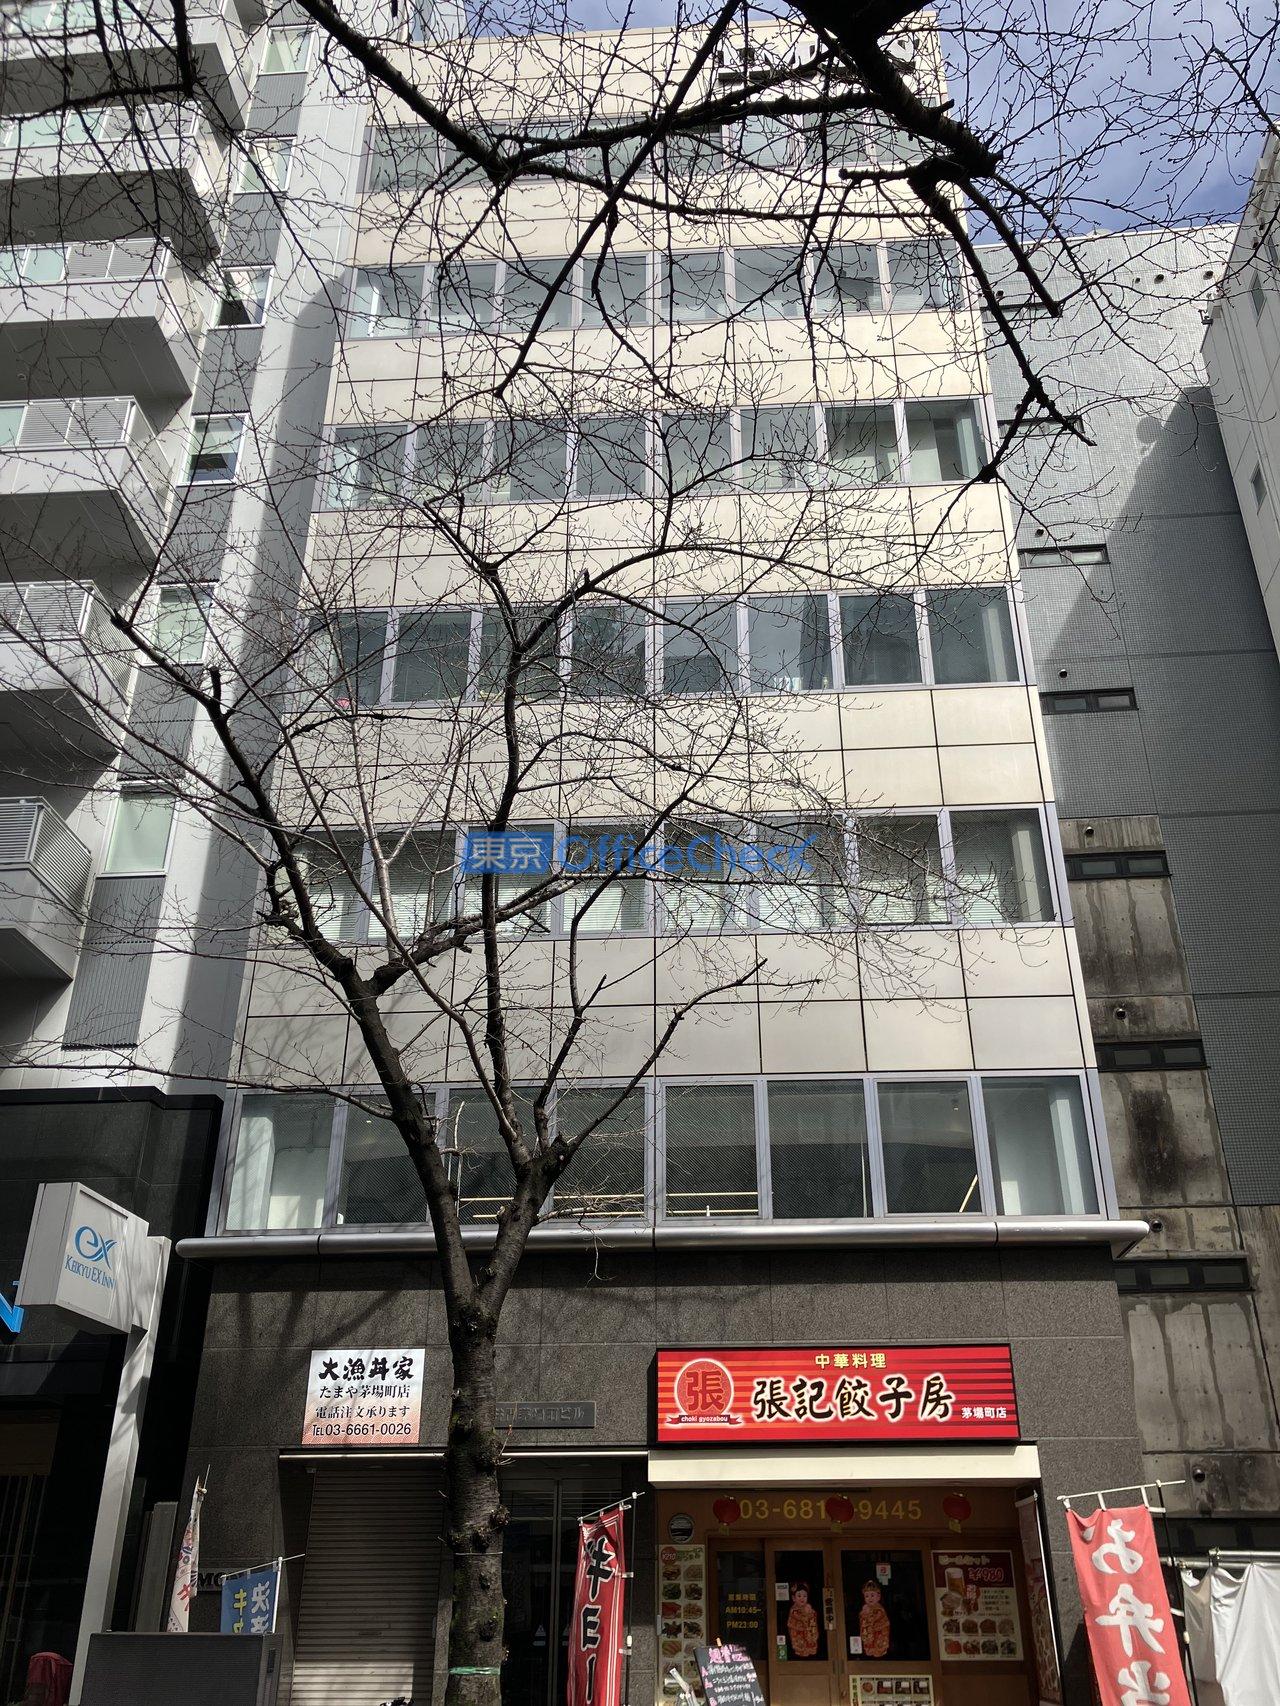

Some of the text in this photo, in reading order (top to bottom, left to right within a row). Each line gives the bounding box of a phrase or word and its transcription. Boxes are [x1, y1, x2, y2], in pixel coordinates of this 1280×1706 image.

[318, 1356, 414, 1381] 大漁丼家
[814, 1353, 888, 1370] 中華料理
[319, 1384, 411, 1399] たまや茅場町店
[686, 1370, 724, 1411] 張
[752, 1374, 955, 1421] 張記餃子房
[315, 1405, 411, 1419] 電話注文承ります
[961, 1407, 1007, 1419] 茅場町店
[739, 1498, 923, 1521] 03-681-9445
